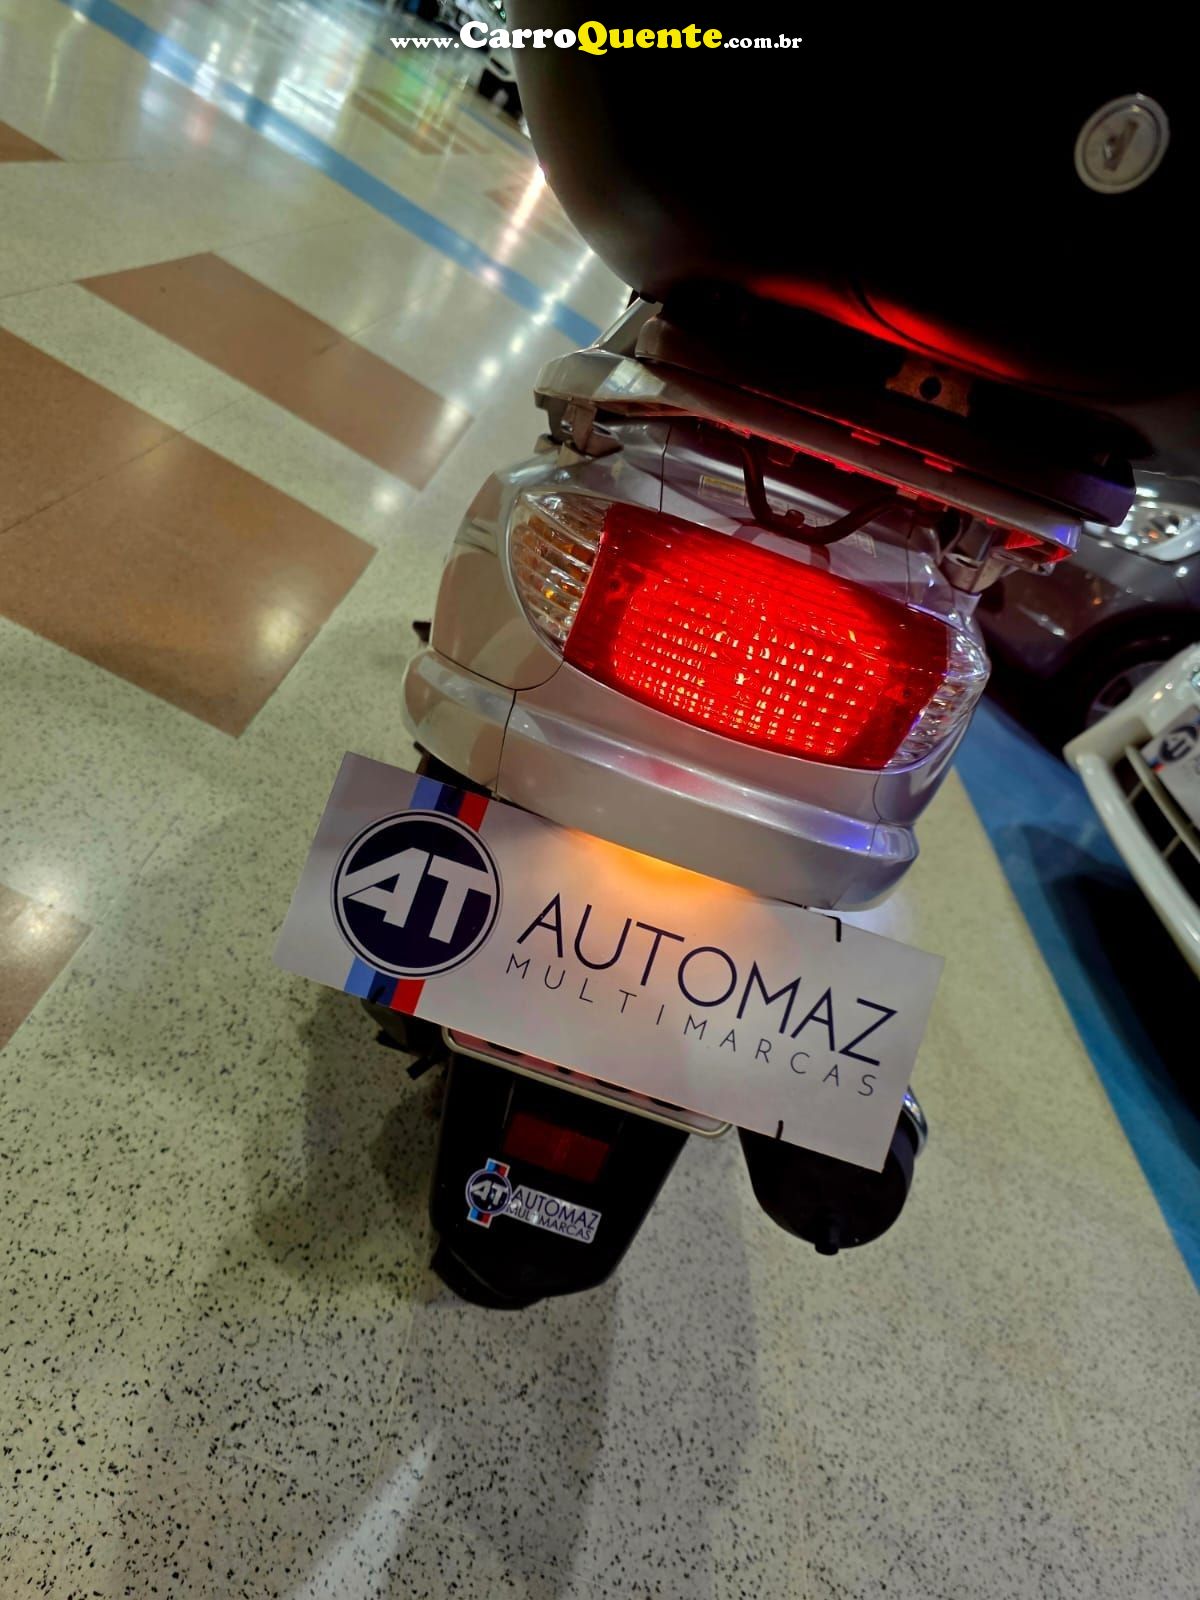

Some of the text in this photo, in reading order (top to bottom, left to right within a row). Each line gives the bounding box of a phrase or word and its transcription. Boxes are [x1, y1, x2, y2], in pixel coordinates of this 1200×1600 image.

[340, 847, 494, 945] AT
[506, 953, 877, 1097] MULTIMARCAS
[517, 893, 899, 1067] AUTOMAZ
[505, 1206, 592, 1241] MULIMARCAS
[512, 1188, 599, 1230] AUTOMAZ
